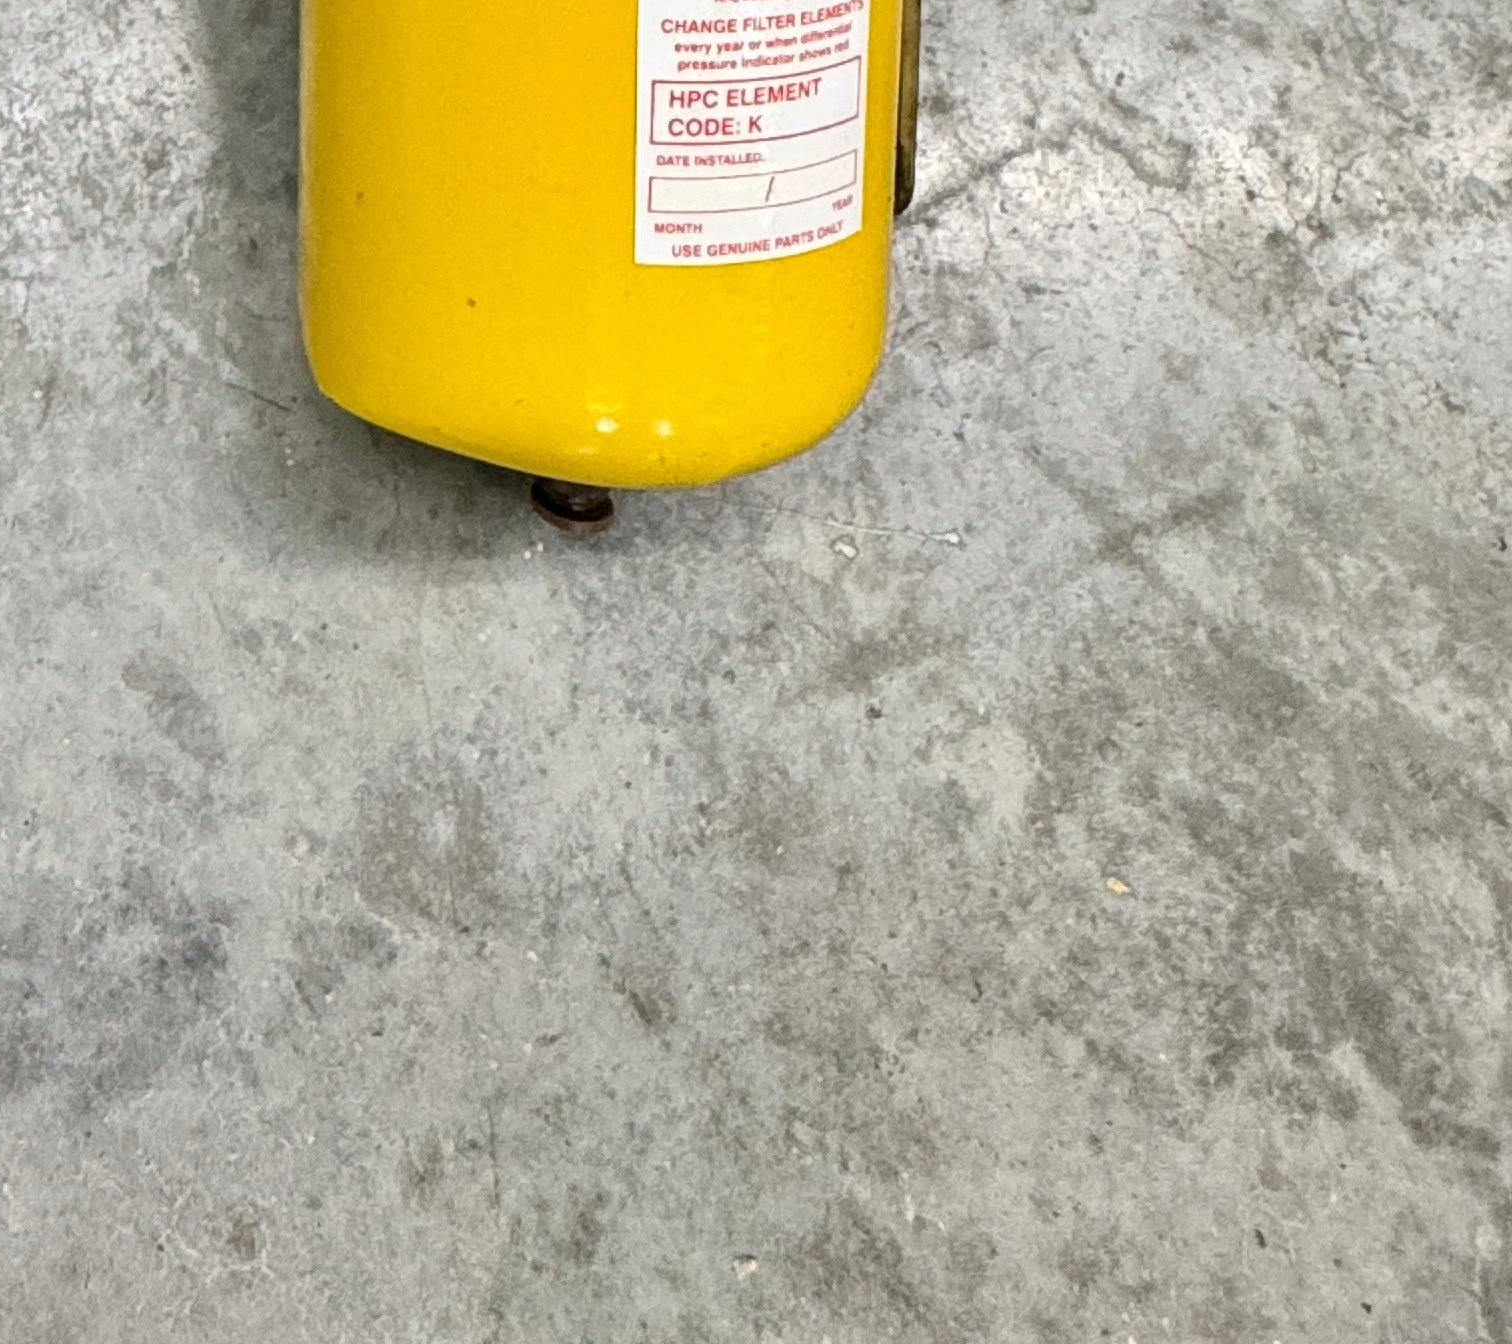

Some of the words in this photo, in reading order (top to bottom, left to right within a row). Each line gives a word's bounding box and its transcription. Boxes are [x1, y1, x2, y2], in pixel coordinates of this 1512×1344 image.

[660, 18, 737, 34] CHANGE
[742, 13, 796, 32] FILTER
[674, 42, 712, 55] every
[716, 41, 745, 55] year
[748, 40, 762, 50] or
[765, 36, 798, 49] when
[677, 60, 737, 73] pressure
[741, 53, 795, 68] indicator
[799, 45, 832, 62] shows
[668, 89, 719, 109] HPC
[726, 77, 823, 108] ELEMENT
[668, 117, 742, 137] CODE:
[748, 114, 764, 134] K
[656, 155, 689, 167] DATE
[654, 223, 703, 234] MONTH
[671, 244, 702, 258] USE
[706, 239, 771, 257] GENUINE
[774, 229, 814, 250] PARTS
[817, 219, 845, 240] ONLY
